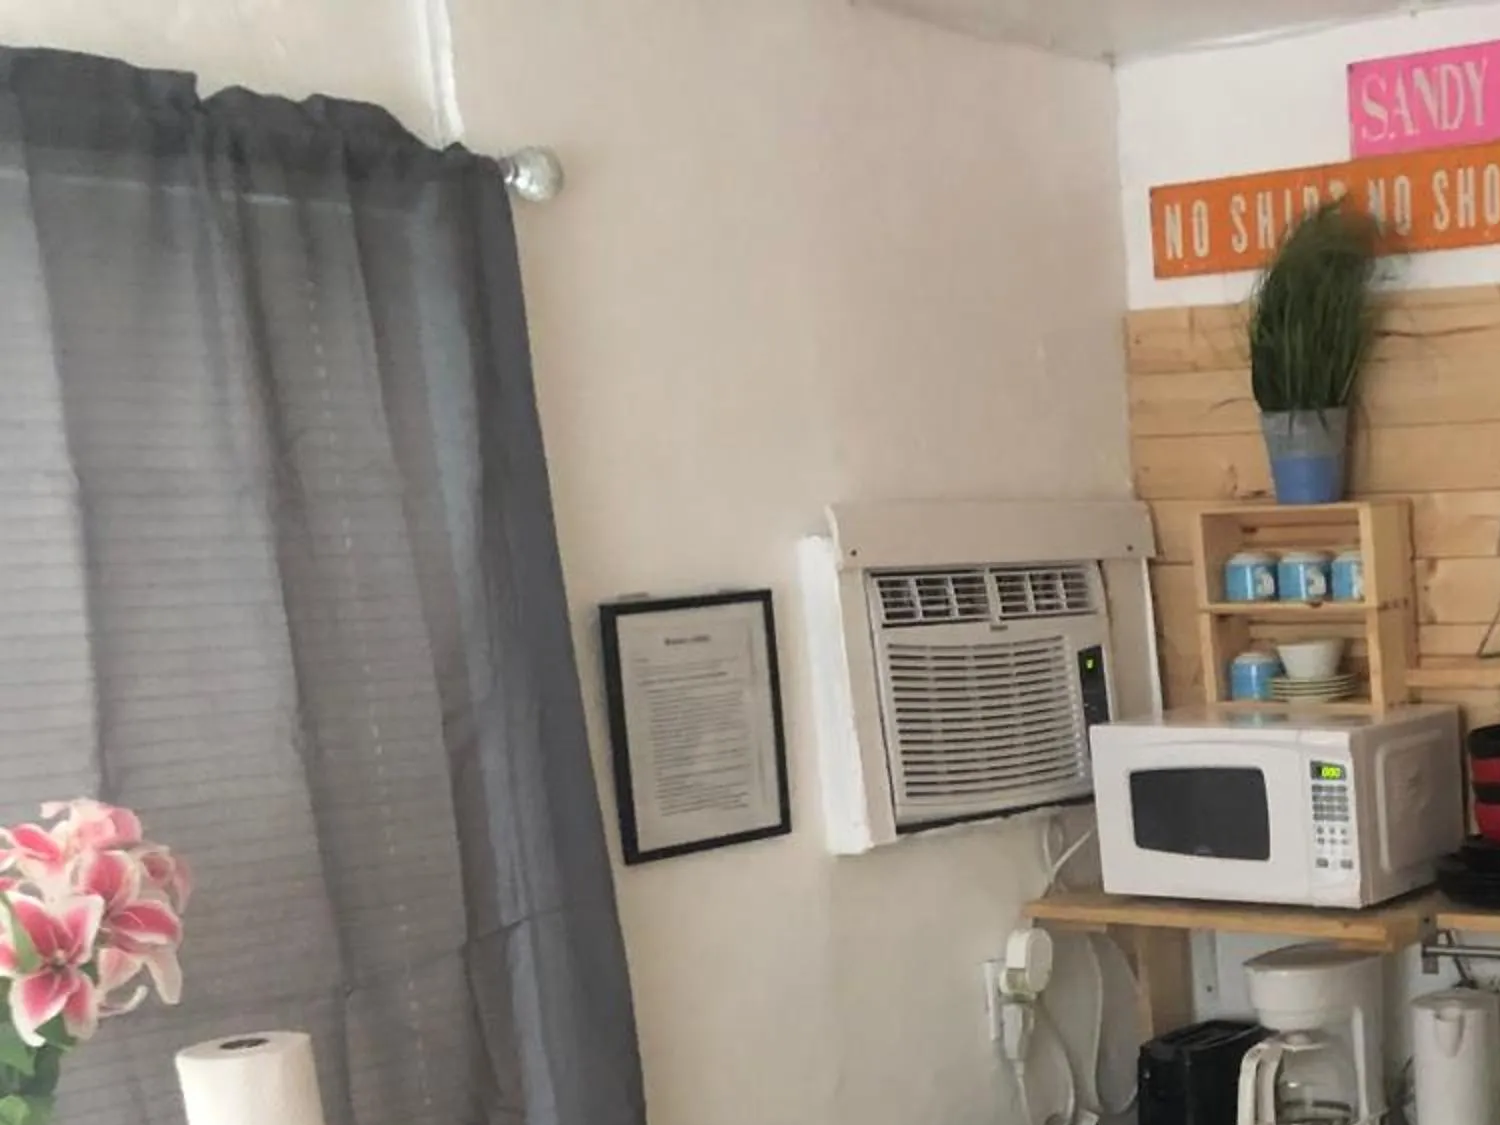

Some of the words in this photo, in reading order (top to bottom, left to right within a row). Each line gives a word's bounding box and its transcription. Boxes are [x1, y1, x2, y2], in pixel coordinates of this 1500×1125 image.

[1361, 57, 1489, 142] SANDY
[1164, 199, 1210, 260] NO
[1229, 180, 1347, 254] SHI
[1367, 174, 1411, 237] NO
